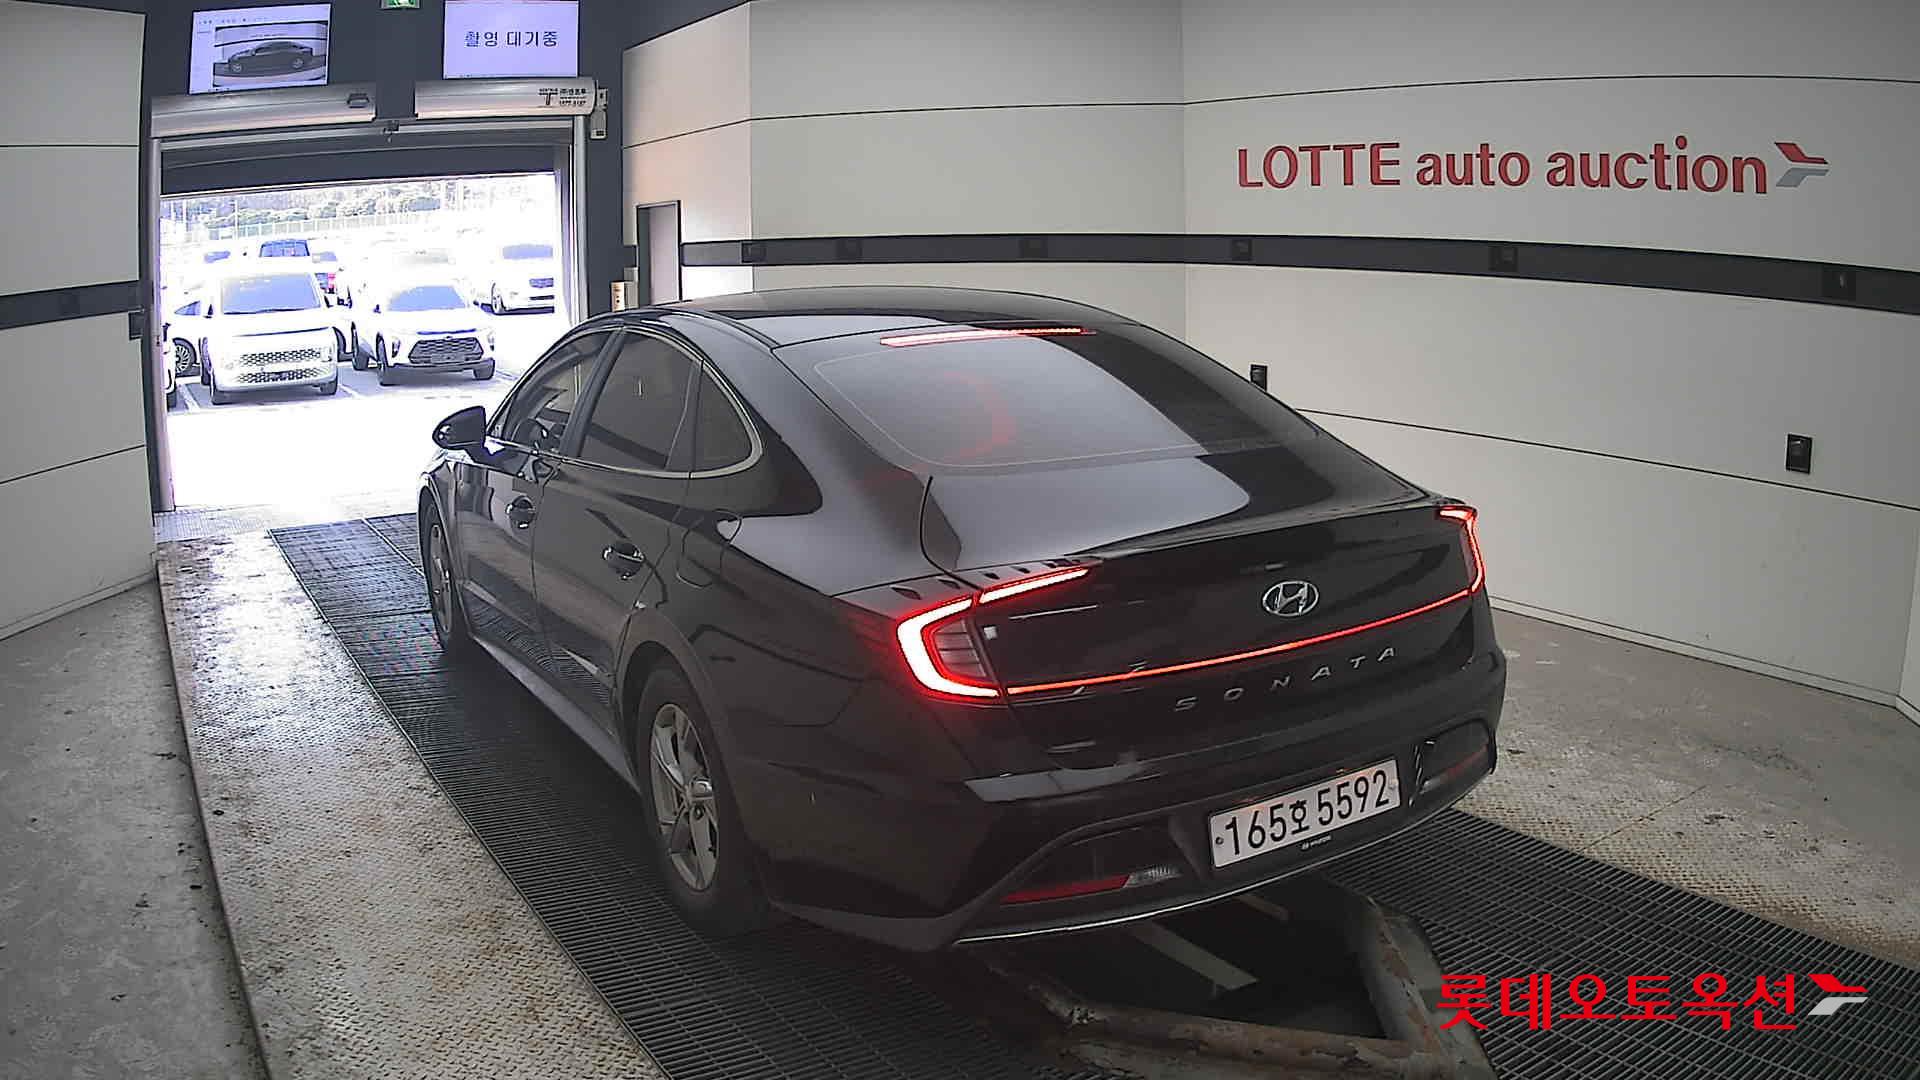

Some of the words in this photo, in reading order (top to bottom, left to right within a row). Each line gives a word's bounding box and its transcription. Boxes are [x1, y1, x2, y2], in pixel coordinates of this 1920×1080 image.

[465, 31, 498, 47] 촬영
[506, 31, 558, 47] 대기중
[1238, 142, 1400, 189] LOTTE
[1416, 142, 1530, 187] auto
[1547, 135, 1768, 194] auction
[1174, 647, 1395, 712] SONATA
[1225, 800, 1310, 855] 165호
[1318, 770, 1389, 826] 5592
